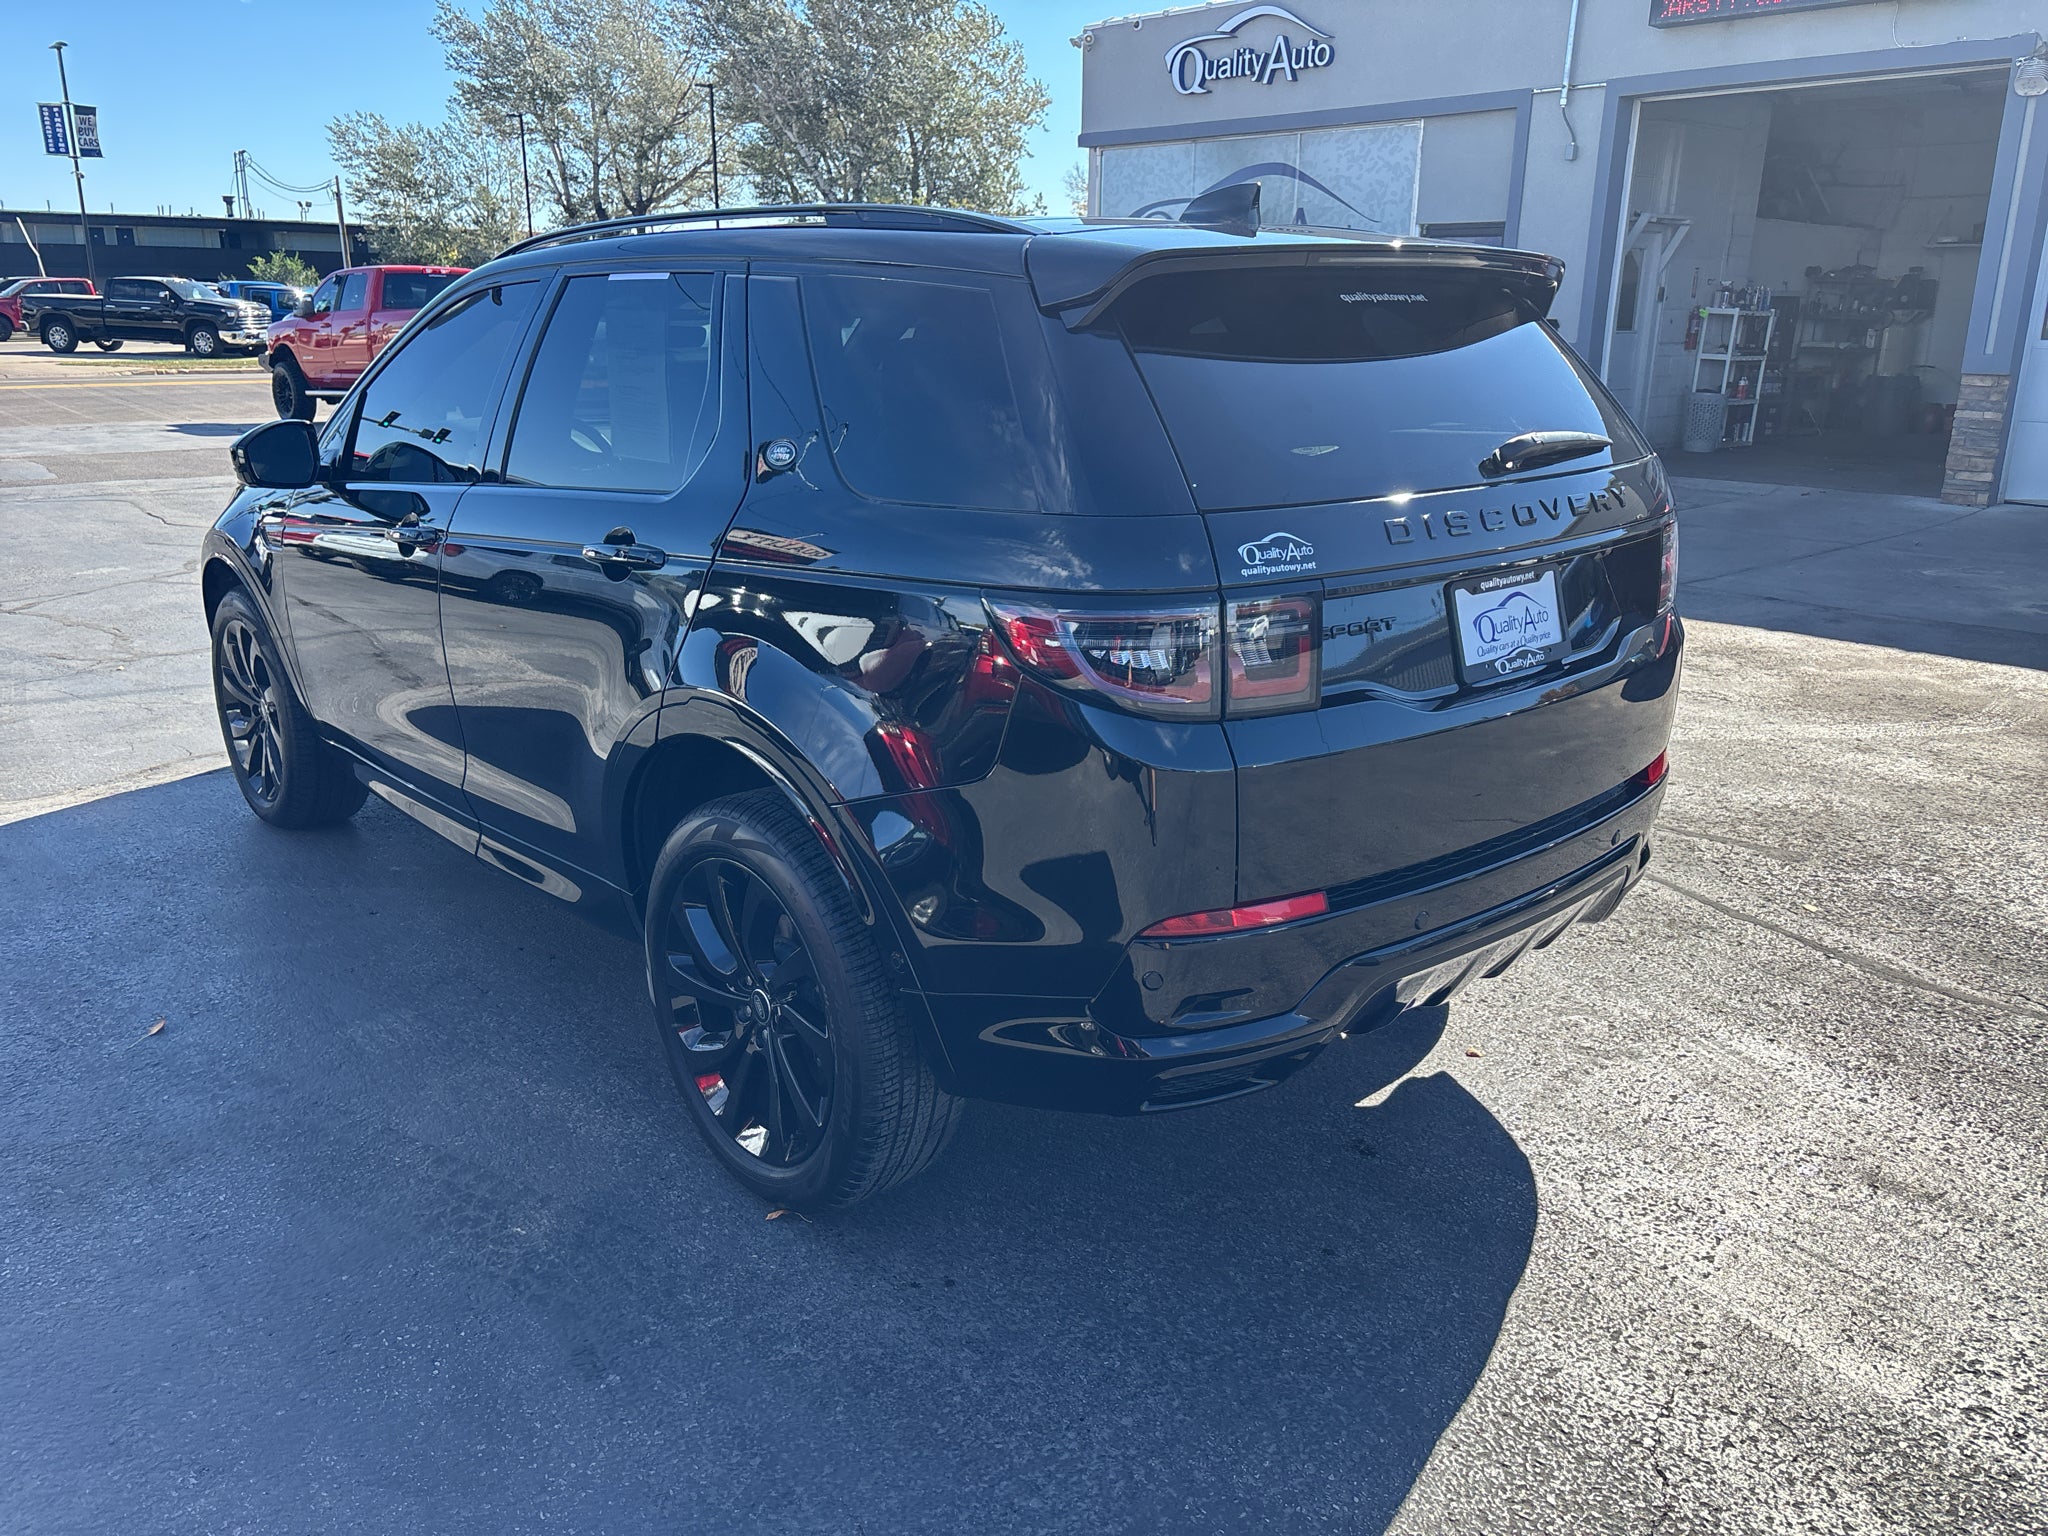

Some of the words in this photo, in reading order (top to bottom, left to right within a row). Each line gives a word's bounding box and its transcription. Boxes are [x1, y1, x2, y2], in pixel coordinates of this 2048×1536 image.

[78, 116, 93, 126] WE
[78, 127, 95, 137] BUY
[78, 138, 100, 147] CARS
[1340, 291, 1429, 304] qualityautowy.net
[1383, 485, 1626, 545] DISCOVERY
[1241, 561, 1317, 577] qualityautowy.net
[1480, 571, 1535, 590] qualityautowy.net
[1477, 645, 1499, 657] Quality
[1499, 642, 1510, 651] cars
[1520, 634, 1539, 647] Quality
[1539, 630, 1551, 642] price
